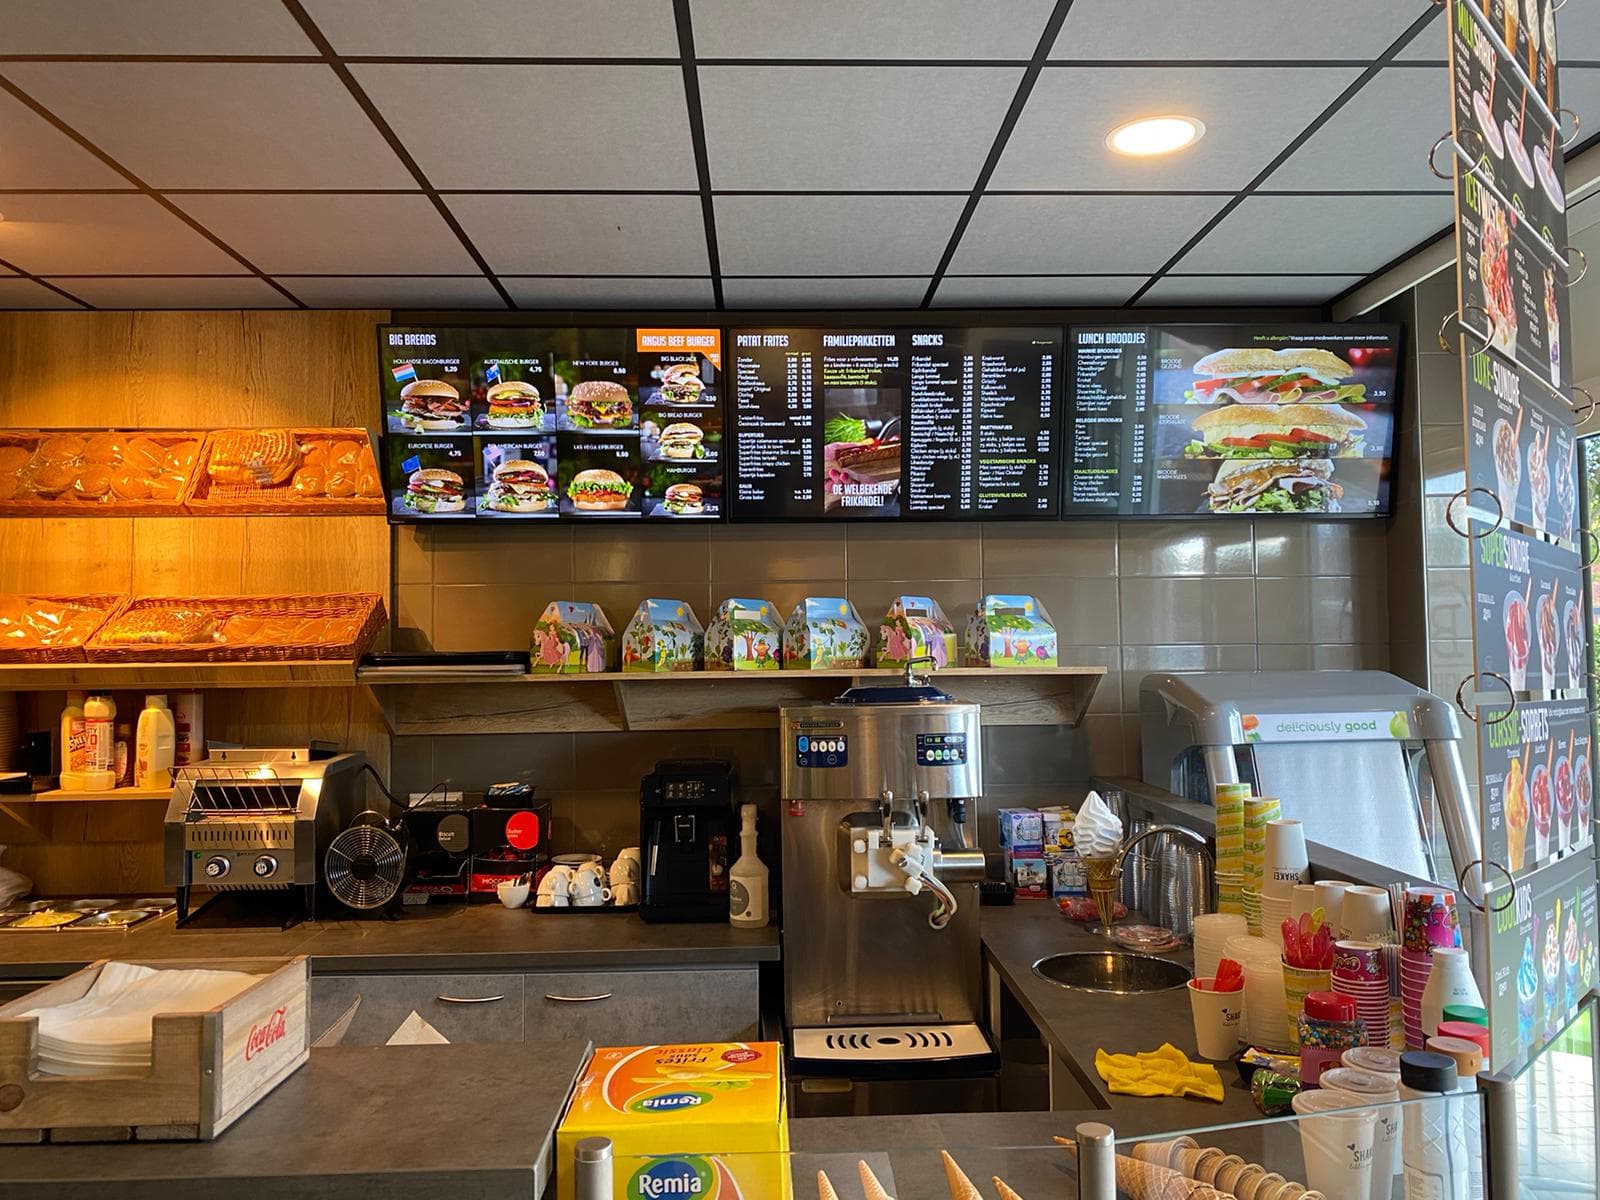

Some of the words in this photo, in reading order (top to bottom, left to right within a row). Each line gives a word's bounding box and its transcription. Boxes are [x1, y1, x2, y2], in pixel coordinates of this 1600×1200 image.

[389, 334, 403, 346] BIG
[405, 334, 437, 346] BREADS
[642, 336, 666, 346] ANGUS
[668, 336, 685, 346] BEEF
[687, 336, 715, 346] BURGER
[737, 335, 761, 346] PATAT
[763, 335, 789, 346] FRITES
[823, 335, 895, 346] FAMILIEPAKKETTEN
[912, 335, 944, 346] SNACKS
[1078, 333, 1104, 344] LUNCH
[1106, 333, 1146, 344] BROODJES
[833, 484, 843, 495] DE
[844, 484, 892, 495] WELBEKENDE
[841, 496, 884, 507] FRIKANDEL!
[1276, 720, 1341, 733] deliciously
[1345, 720, 1376, 733] good
[654, 1046, 715, 1055] Classic
[642, 1095, 702, 1107] Remia
[639, 1173, 702, 1198] Remia
